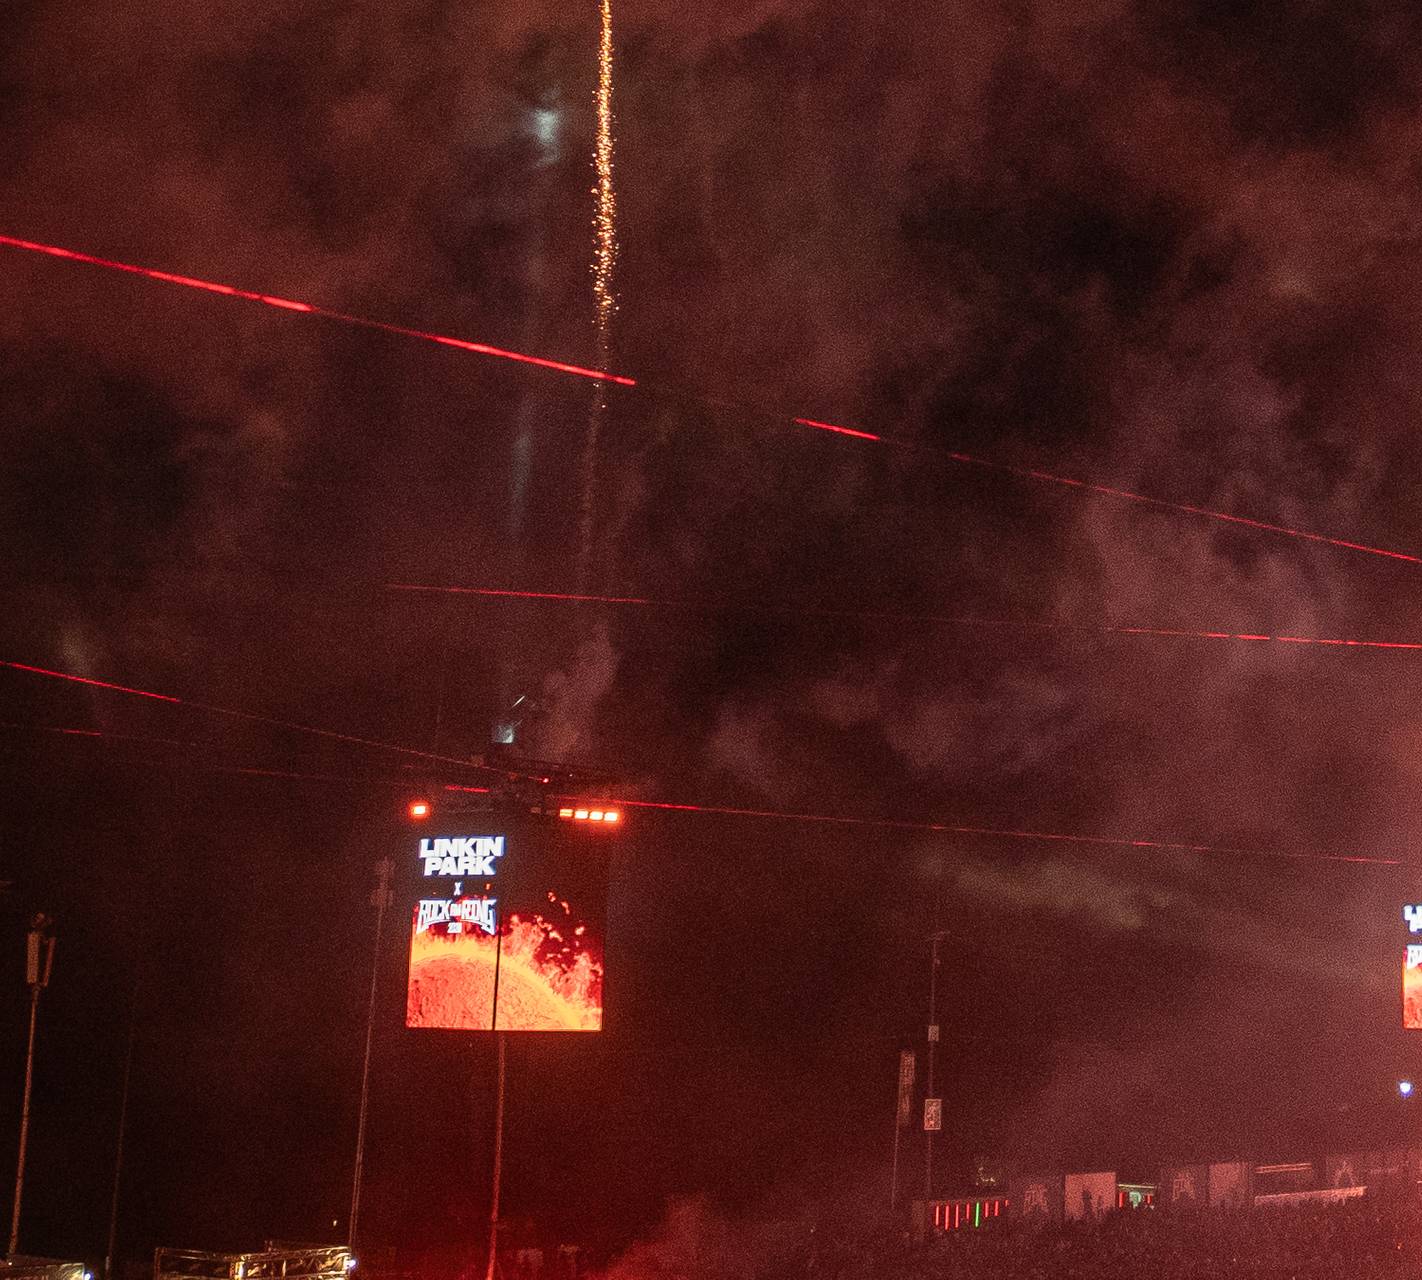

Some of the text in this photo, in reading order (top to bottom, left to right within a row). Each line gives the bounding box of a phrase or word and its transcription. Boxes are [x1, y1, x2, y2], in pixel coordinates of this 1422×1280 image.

[419, 836, 504, 858] LINKIN
[424, 857, 496, 876] PARK
[416, 899, 497, 935] ROCK RING
